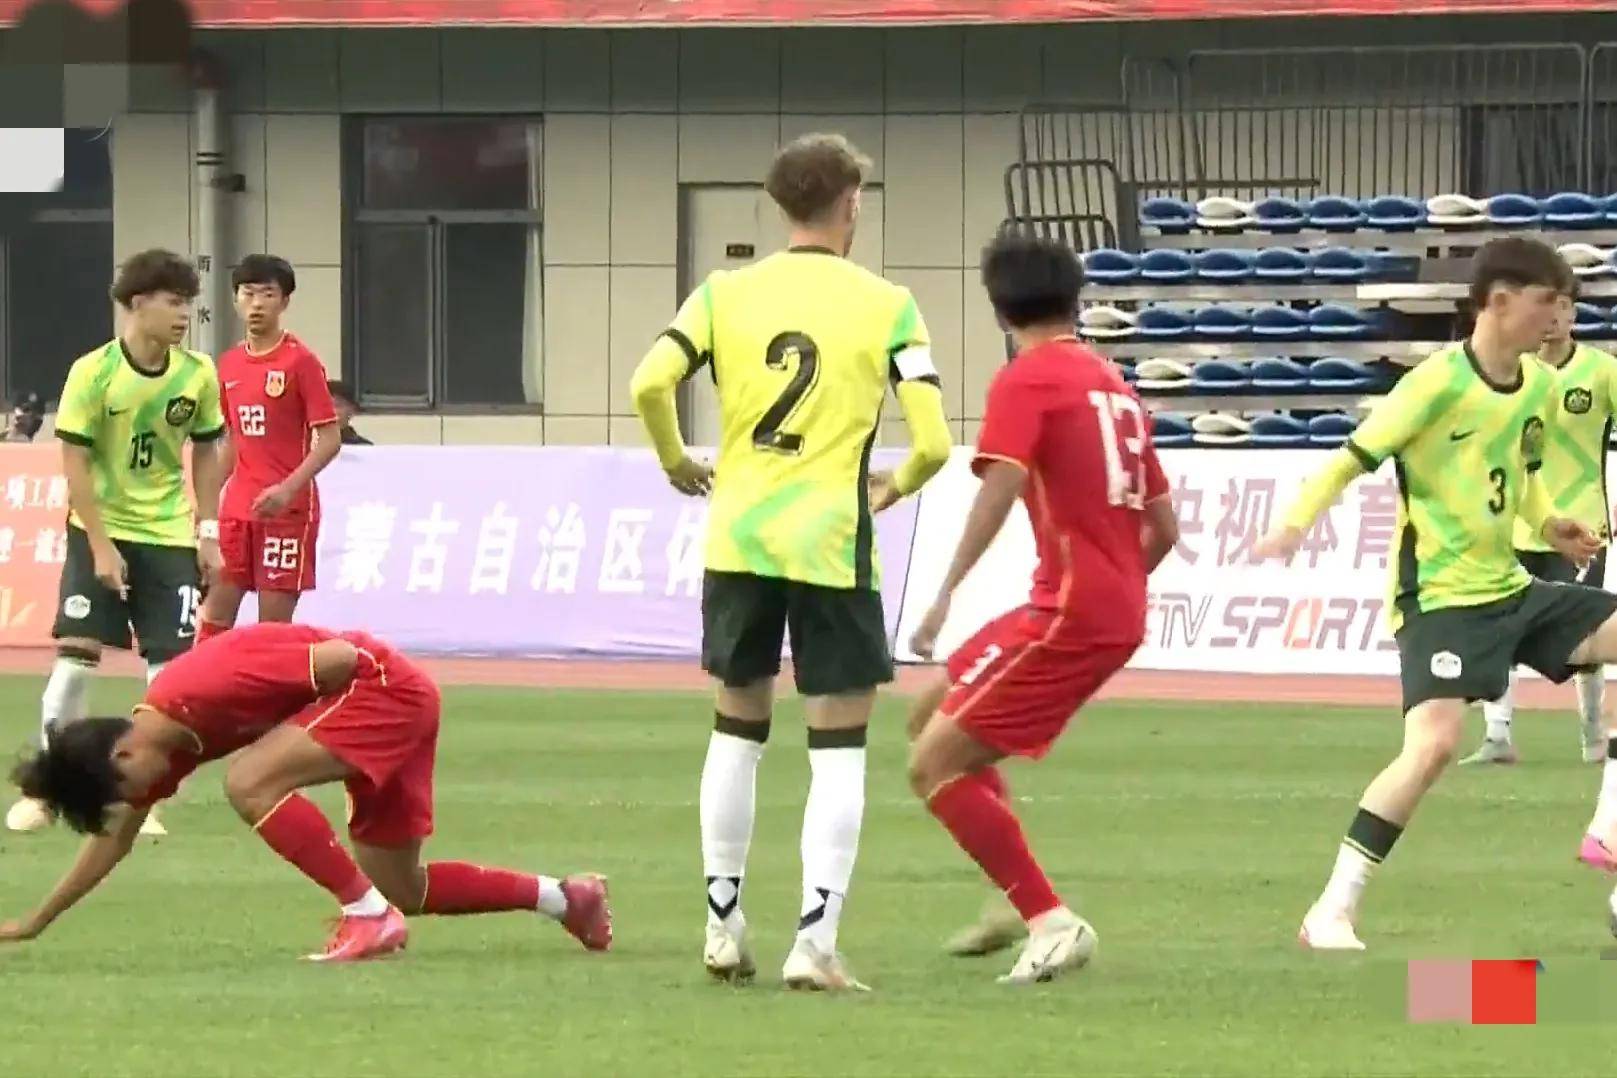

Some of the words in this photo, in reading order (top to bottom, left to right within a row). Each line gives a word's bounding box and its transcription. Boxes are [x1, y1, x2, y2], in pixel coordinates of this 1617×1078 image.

[237, 404, 267, 437] 22
[752, 330, 822, 456] 2
[129, 431, 157, 470] 15
[1087, 390, 1147, 511] 13
[1487, 466, 1507, 517] 3
[262, 536, 299, 570] 22
[320, 501, 708, 597] 蒙古自治区体
[1146, 591, 1215, 650] TV
